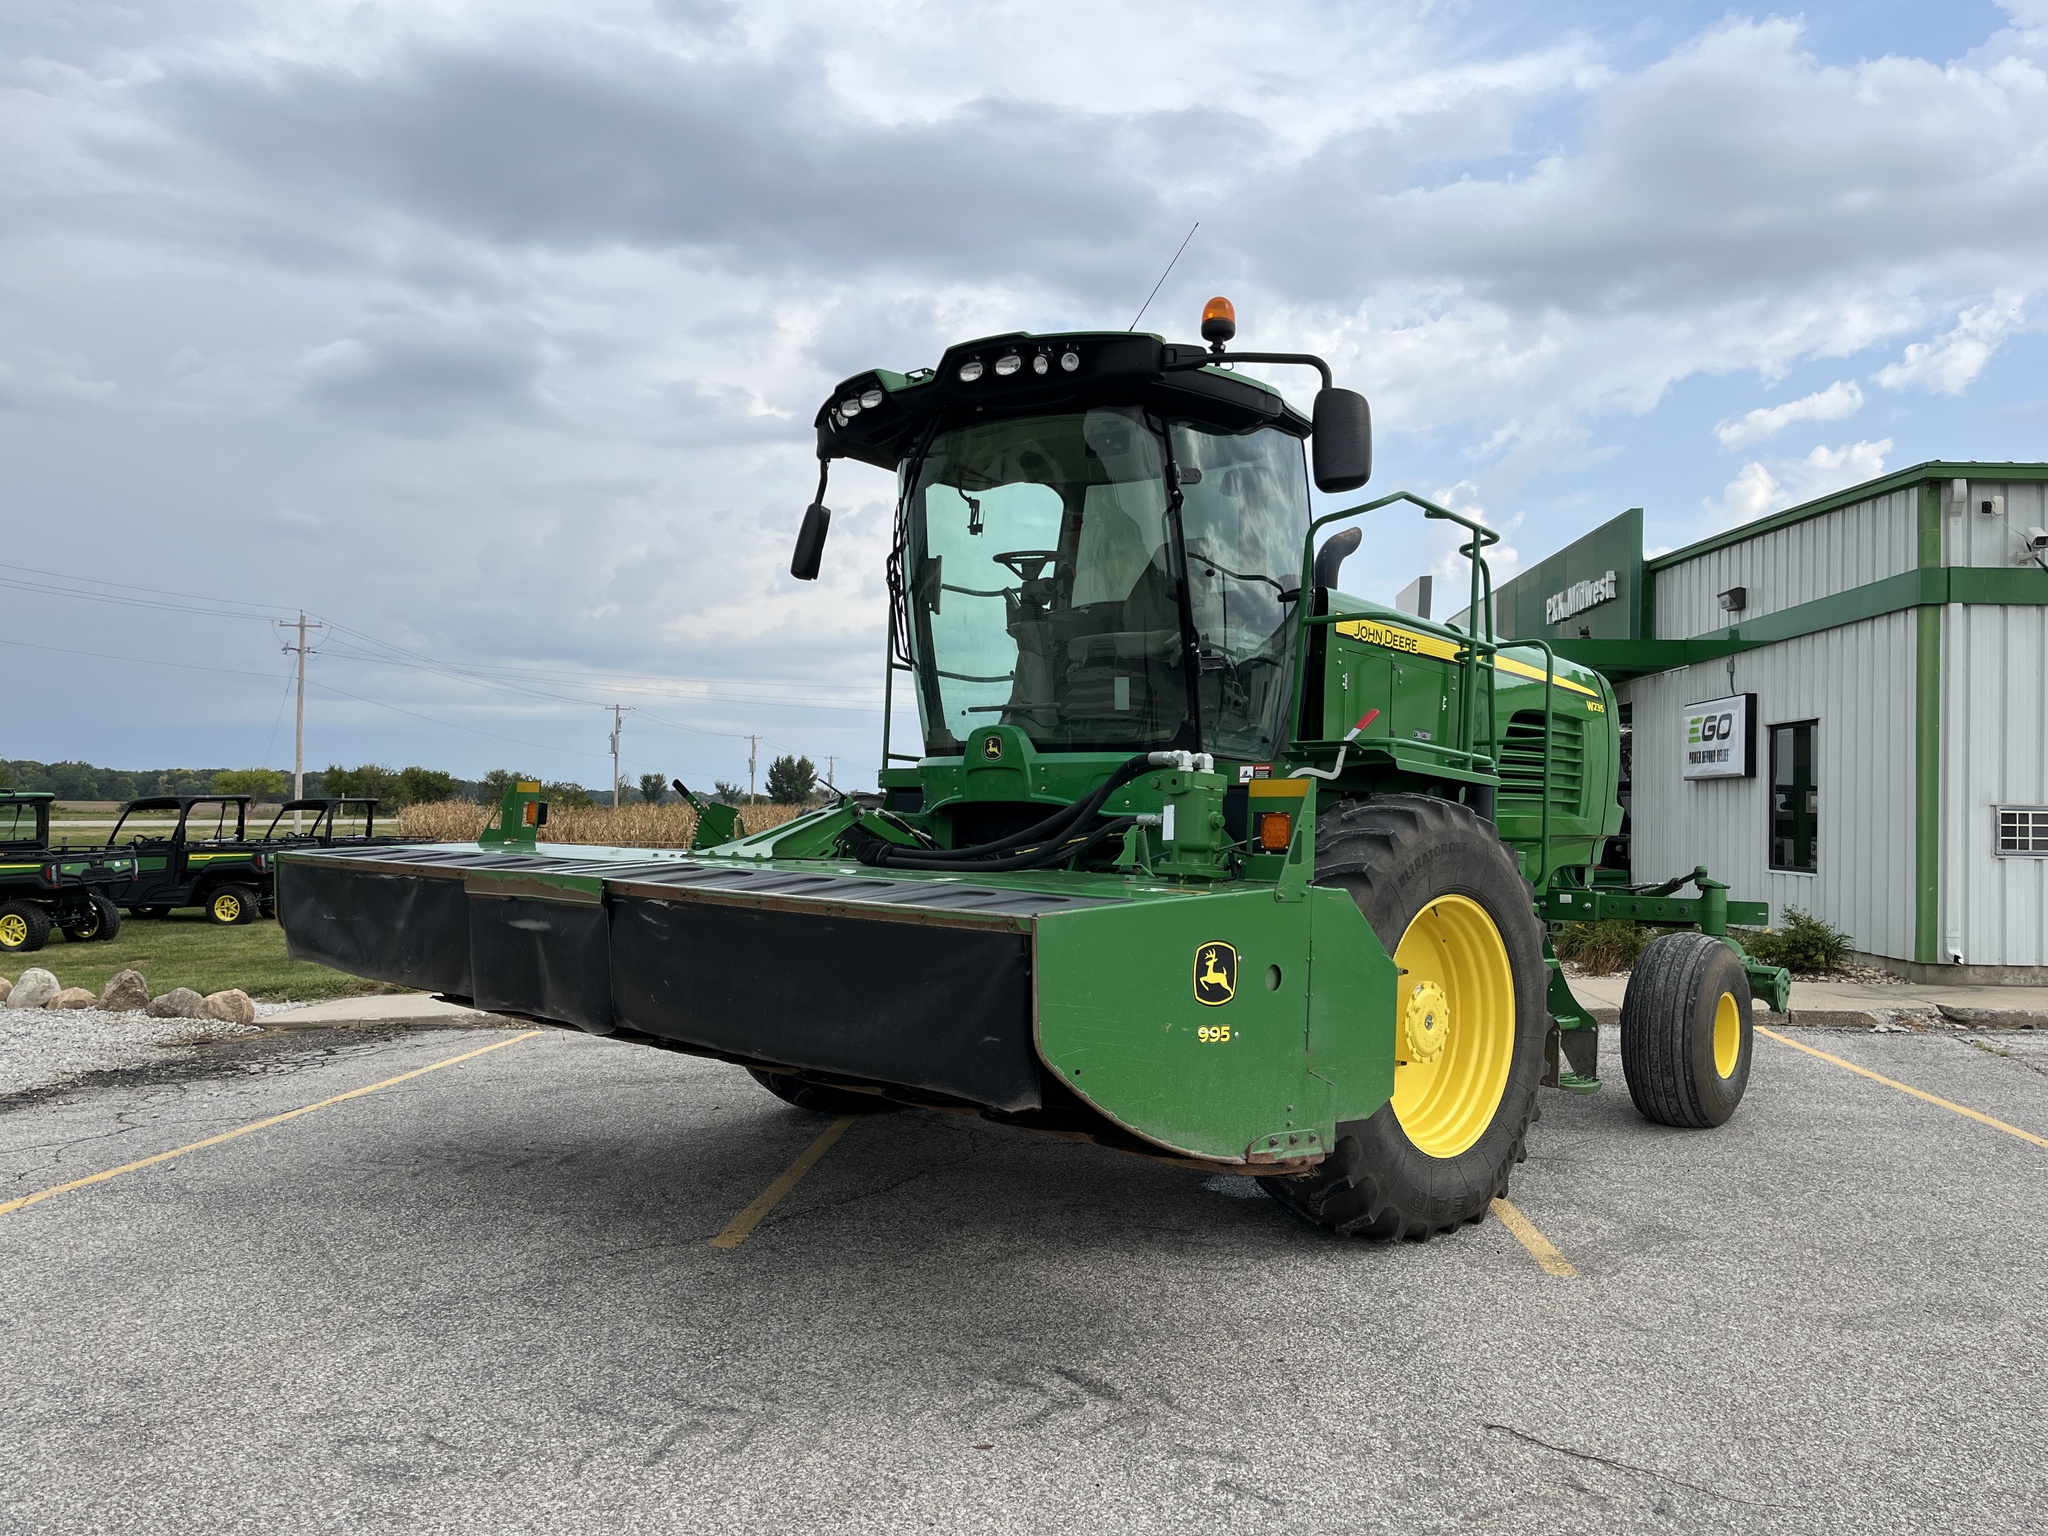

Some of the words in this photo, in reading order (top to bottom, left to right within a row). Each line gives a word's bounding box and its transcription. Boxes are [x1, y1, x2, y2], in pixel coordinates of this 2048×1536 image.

[1546, 591, 1570, 625] P&K
[1567, 570, 1617, 617] Midwest
[1353, 622, 1383, 645] JOHN
[1384, 629, 1418, 653] DEERE
[1586, 700, 1605, 713] W235
[1688, 713, 1733, 743] EGO
[1197, 1025, 1231, 1043] 995
